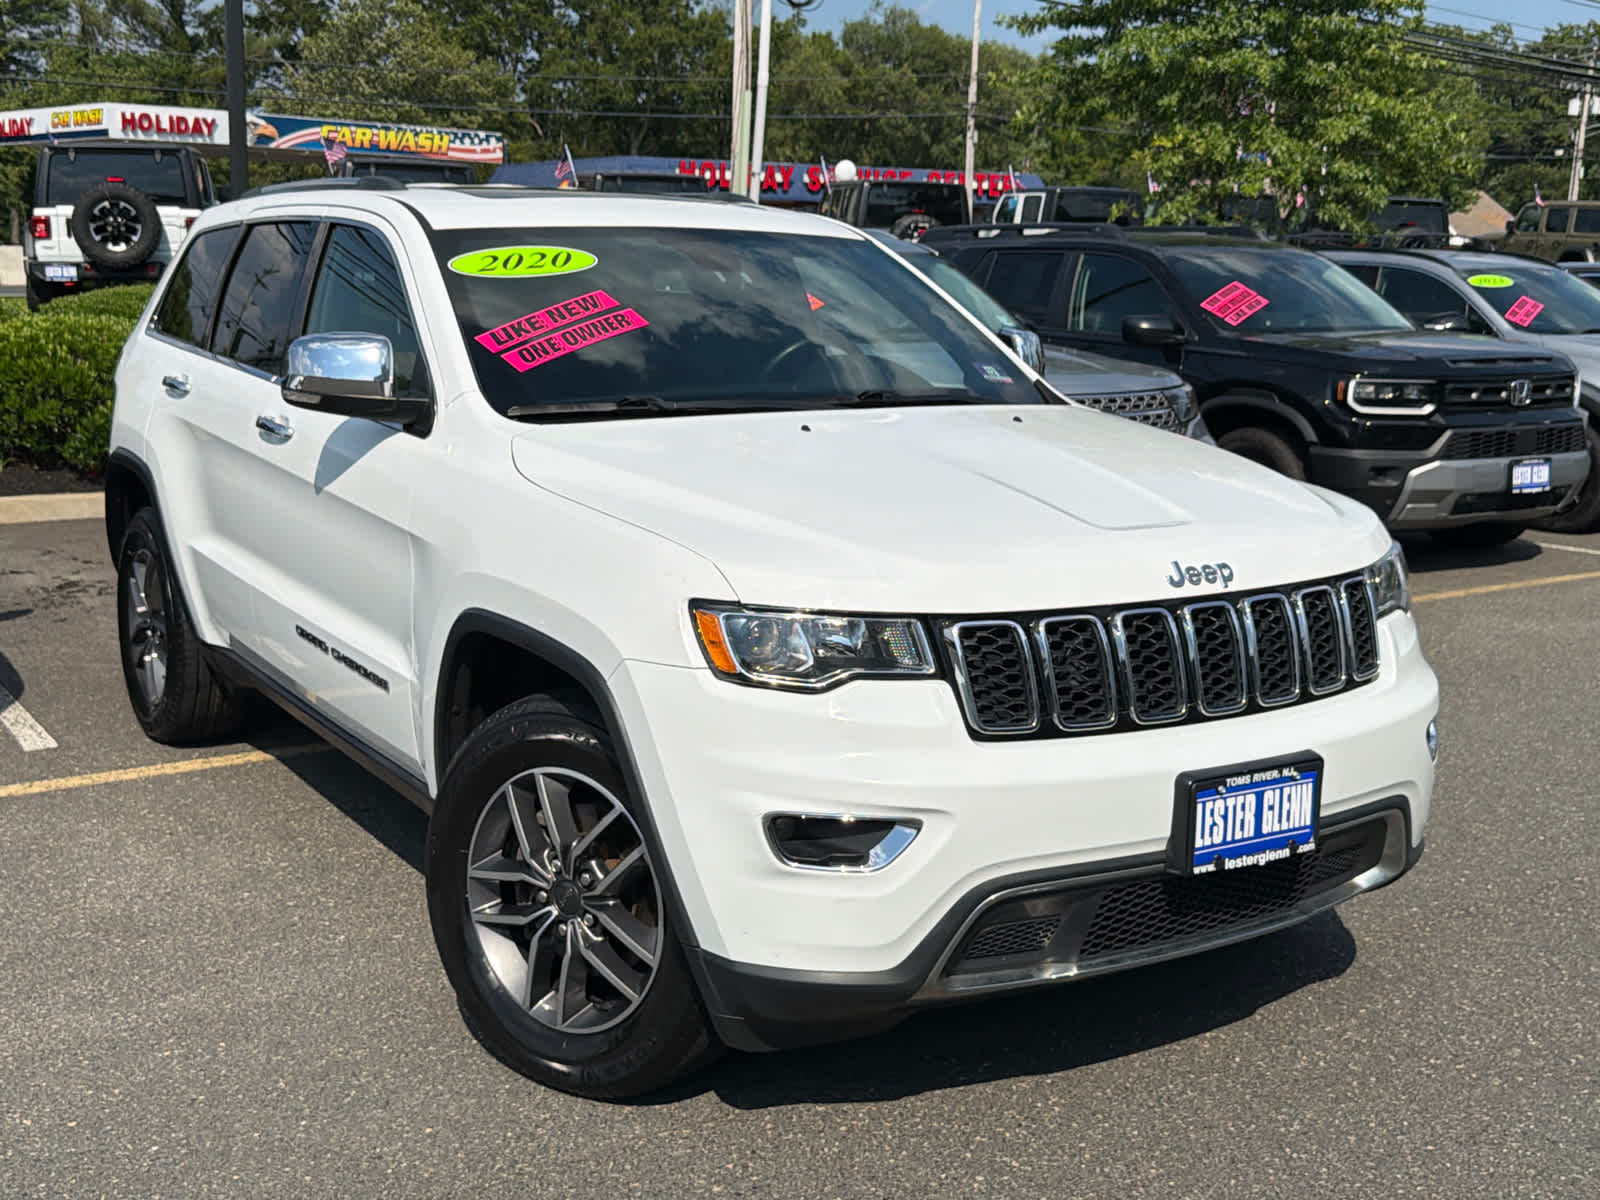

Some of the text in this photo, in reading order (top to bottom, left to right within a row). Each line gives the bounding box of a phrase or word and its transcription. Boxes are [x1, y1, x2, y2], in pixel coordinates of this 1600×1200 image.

[51, 108, 104, 129] CAR WASH
[121, 111, 216, 136] HOLIDAY
[378, 129, 450, 153] WASH
[477, 251, 572, 273] 2020
[488, 294, 602, 346] LIKE NEW
[518, 313, 631, 364] ONE OWNER
[1168, 560, 1234, 588] Jeep
[1226, 774, 1251, 787] TOMS
[1195, 782, 1313, 849] LESTER GLENN
